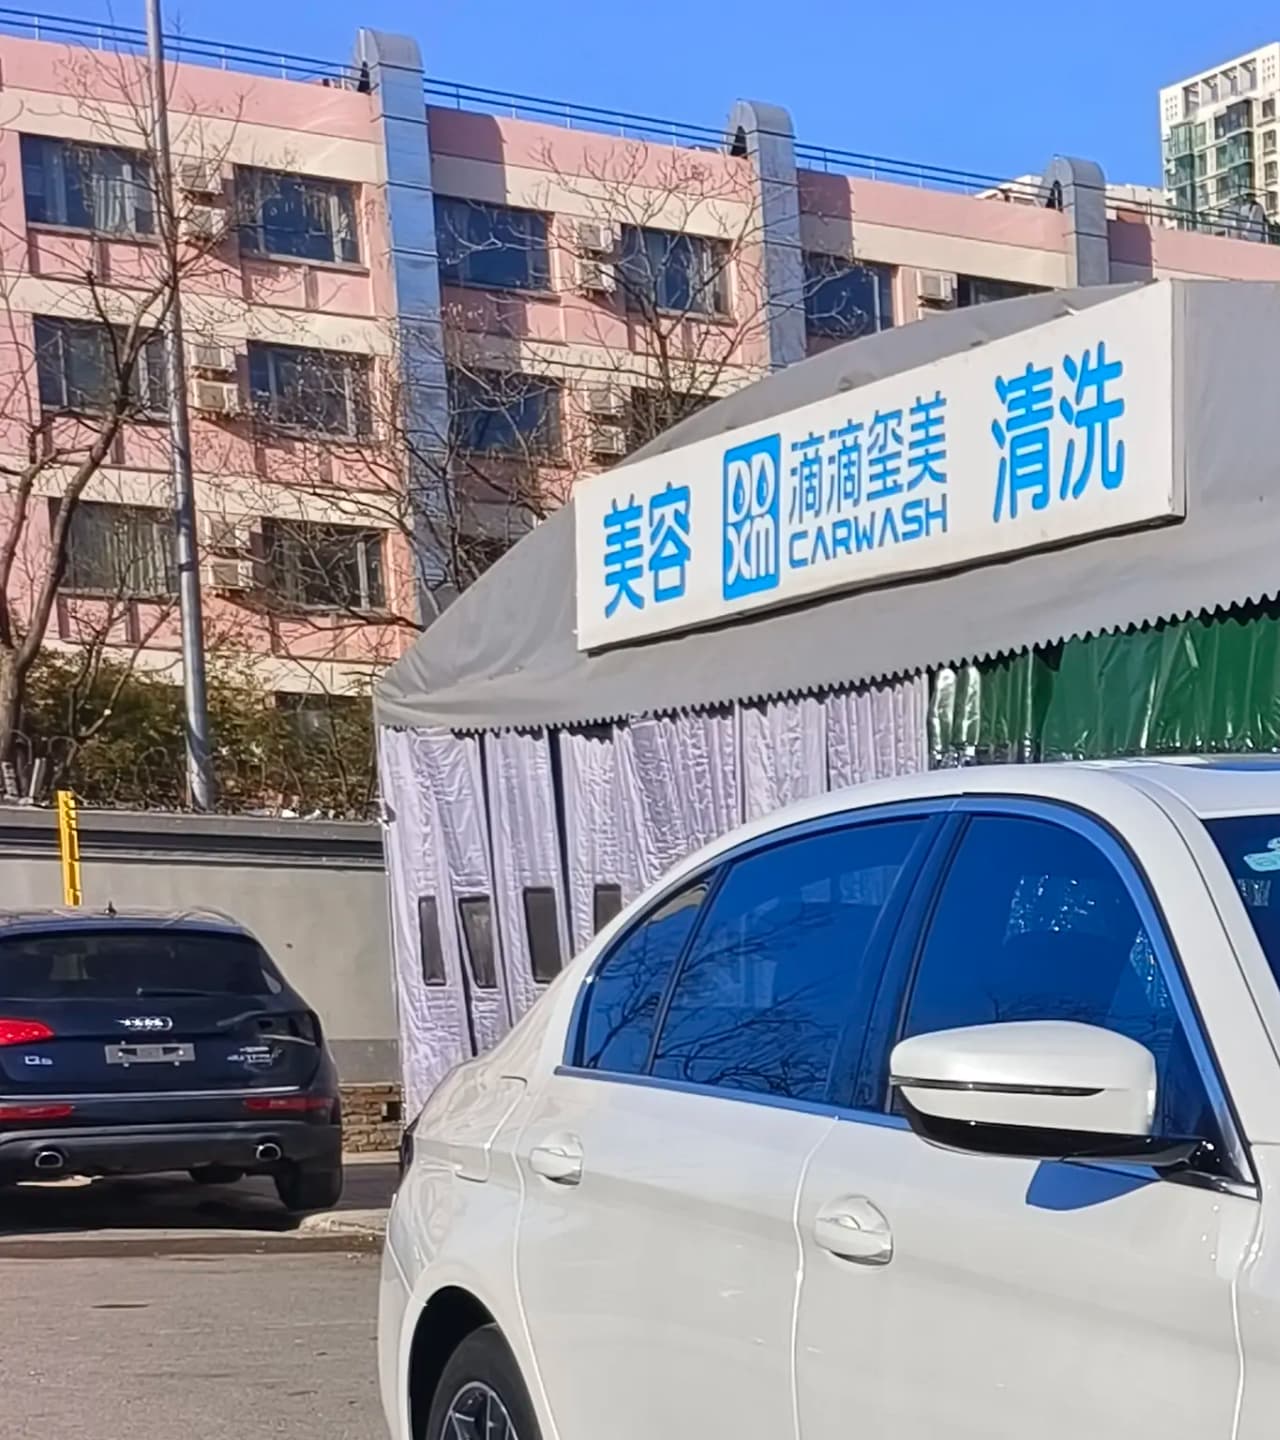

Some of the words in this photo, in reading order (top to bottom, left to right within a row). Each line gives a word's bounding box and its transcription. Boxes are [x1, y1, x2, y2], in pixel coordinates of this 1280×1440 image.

[789, 390, 948, 525] 滴滴玺美
[992, 341, 1125, 522] 清洗
[603, 481, 692, 619] 美容
[788, 492, 948, 569] CARWASH
